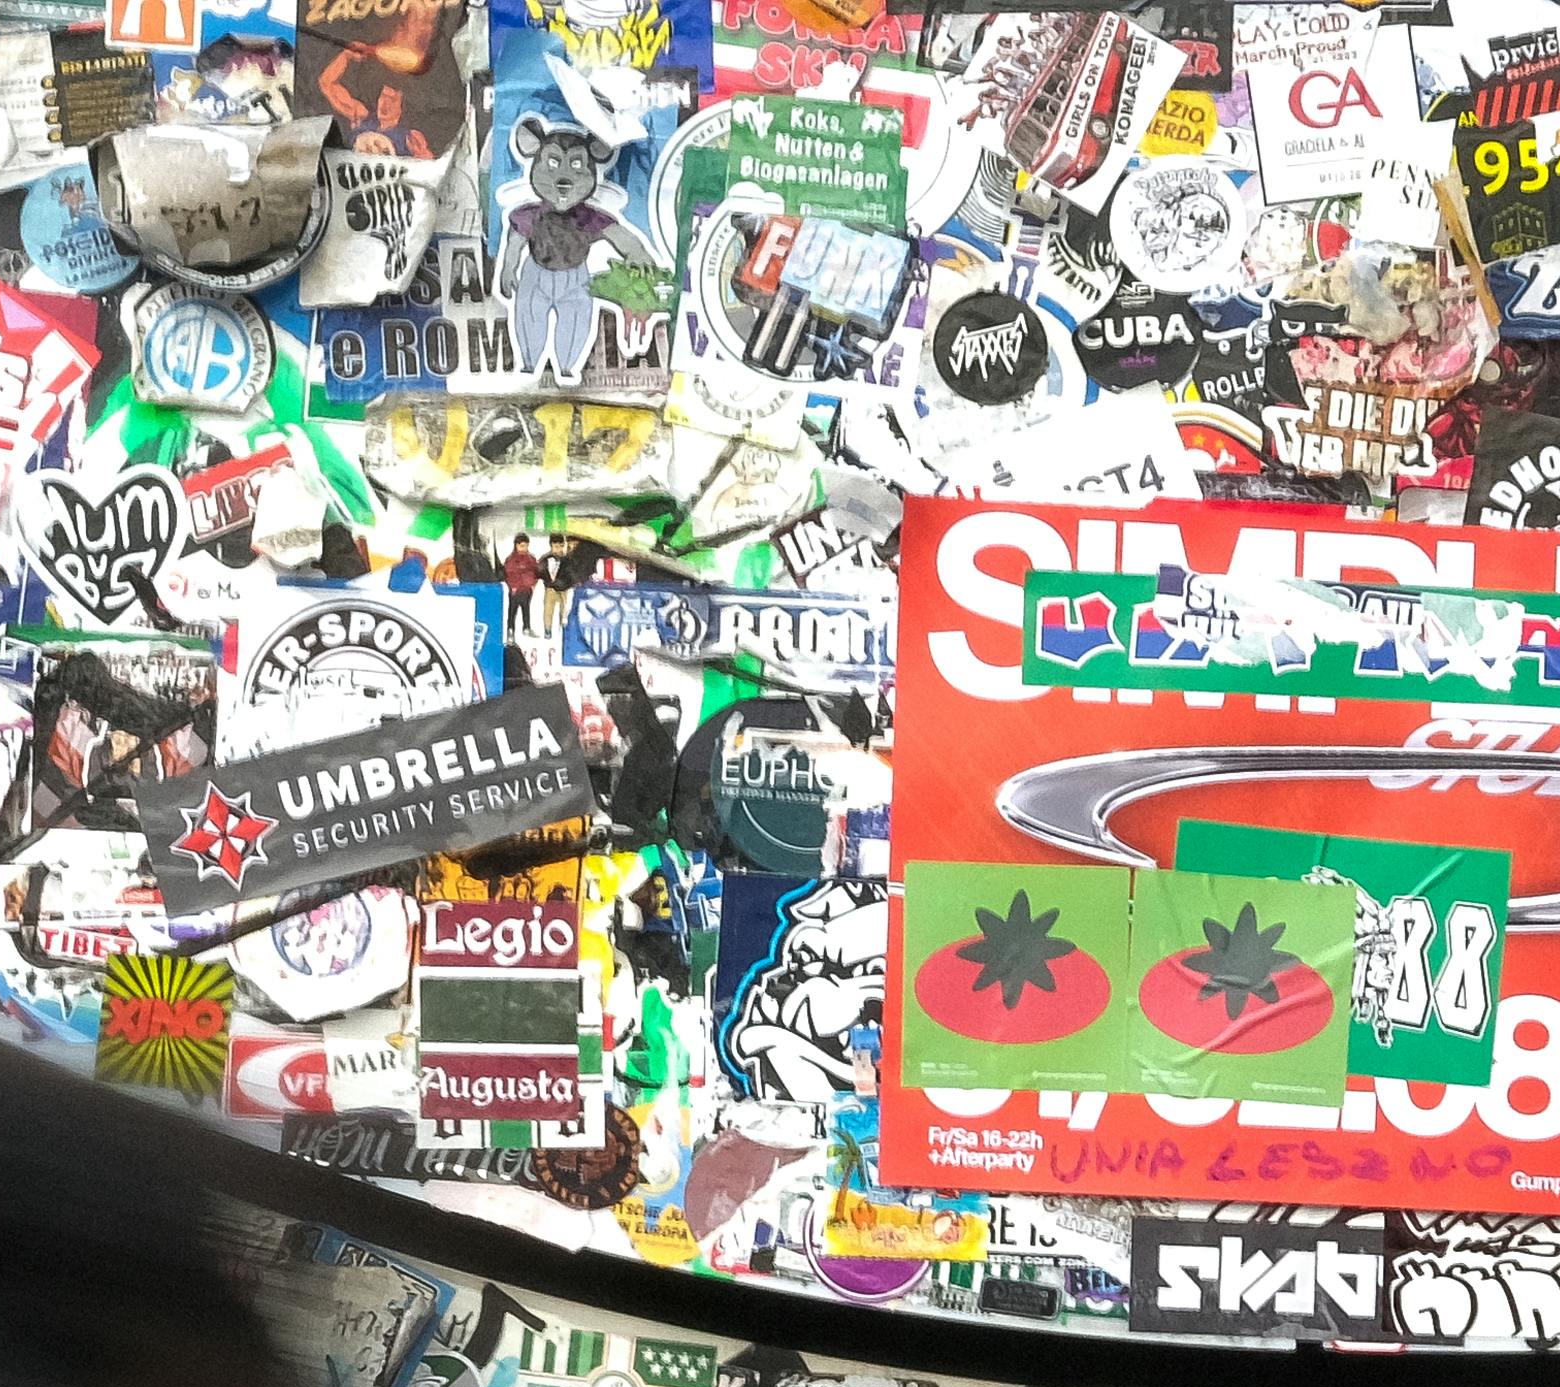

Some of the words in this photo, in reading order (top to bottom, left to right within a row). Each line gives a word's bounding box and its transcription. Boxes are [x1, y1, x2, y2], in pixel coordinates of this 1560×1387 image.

[791, 104, 845, 135] Koks,
[775, 134, 849, 158] Nutten
[1080, 315, 1190, 349] CUBA
[43, 478, 171, 552] Mum
[276, 715, 565, 818] UMBRELLA
[291, 800, 440, 859] SECURITY
[449, 765, 574, 820] SERVICE
[422, 904, 574, 959] Legio
[1390, 896, 1498, 1038] 88
[108, 1000, 225, 1044] XINO
[422, 1070, 576, 1108] Augusta
[928, 1127, 977, 1150] Fr/Sa
[980, 1127, 1044, 1152] 16-22h
[929, 1149, 1035, 1173] +Afterparty
